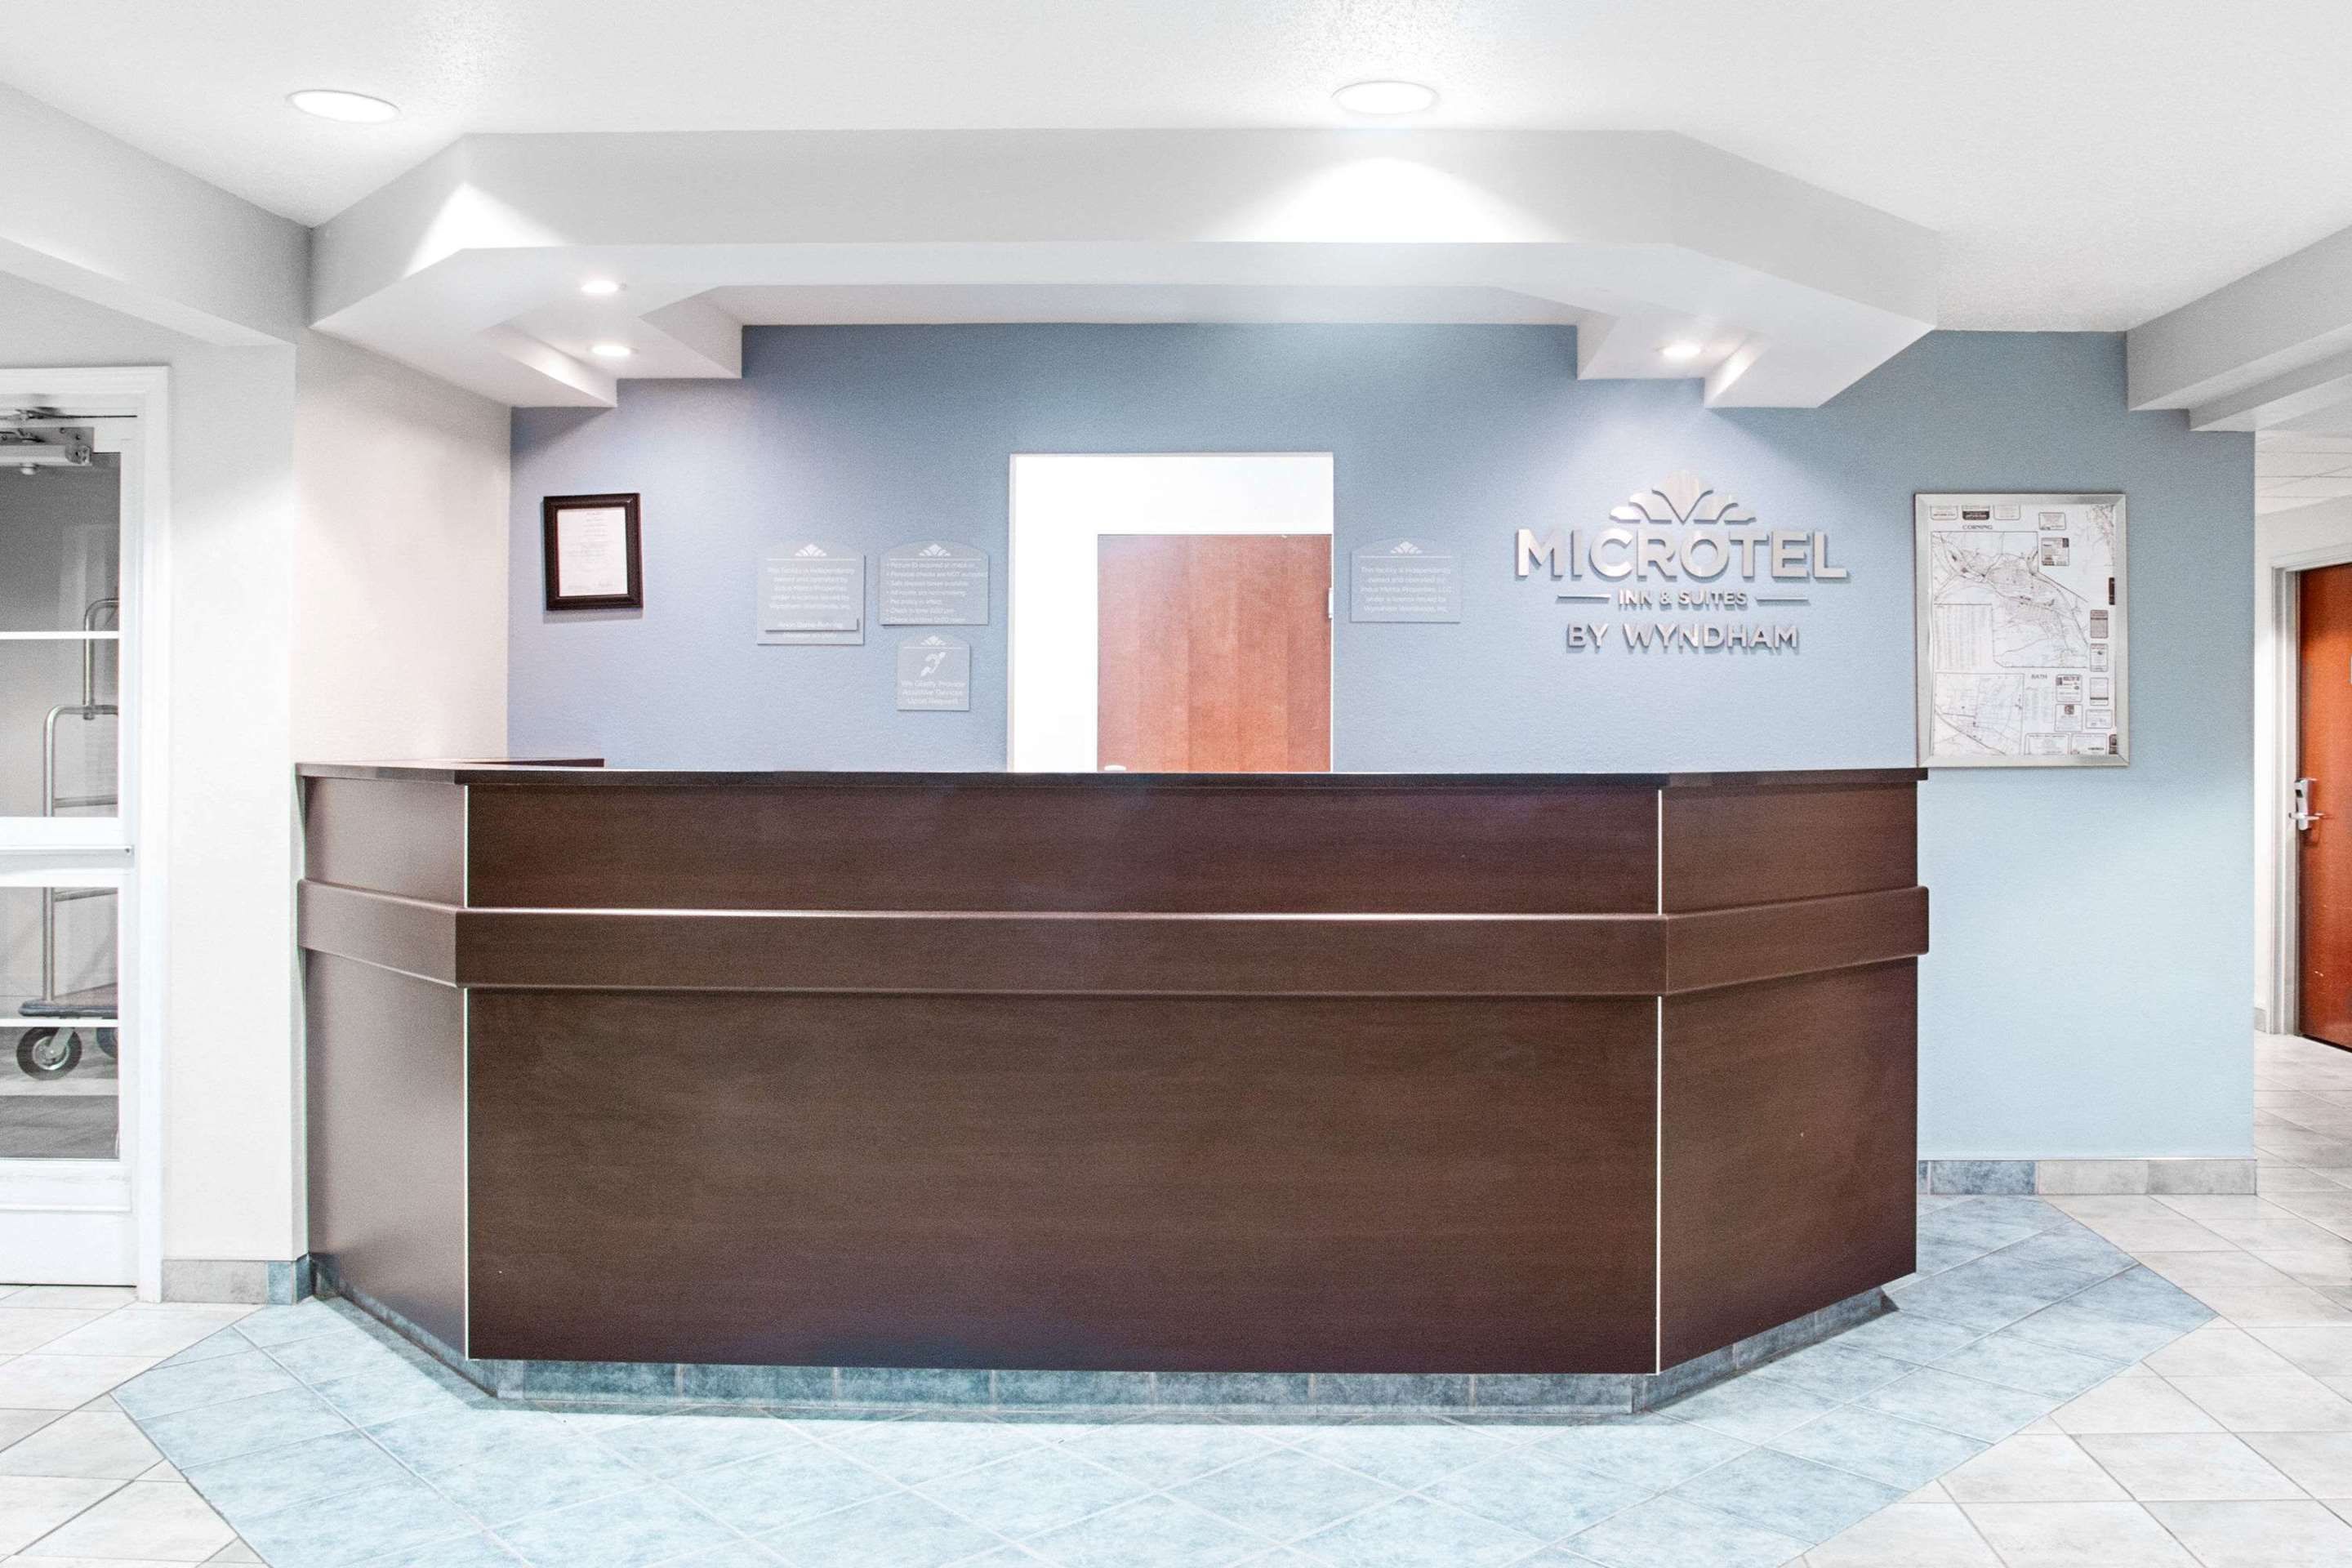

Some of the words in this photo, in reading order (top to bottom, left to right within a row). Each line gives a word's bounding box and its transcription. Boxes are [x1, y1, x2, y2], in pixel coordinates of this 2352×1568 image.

[1516, 527, 1849, 579] MICROTEL
[1619, 589, 1650, 605] INN
[1659, 590, 1673, 605] &
[1678, 589, 1748, 606] SUITES
[1567, 623, 1609, 648] BY
[1622, 623, 1797, 648] WYNDHAM
